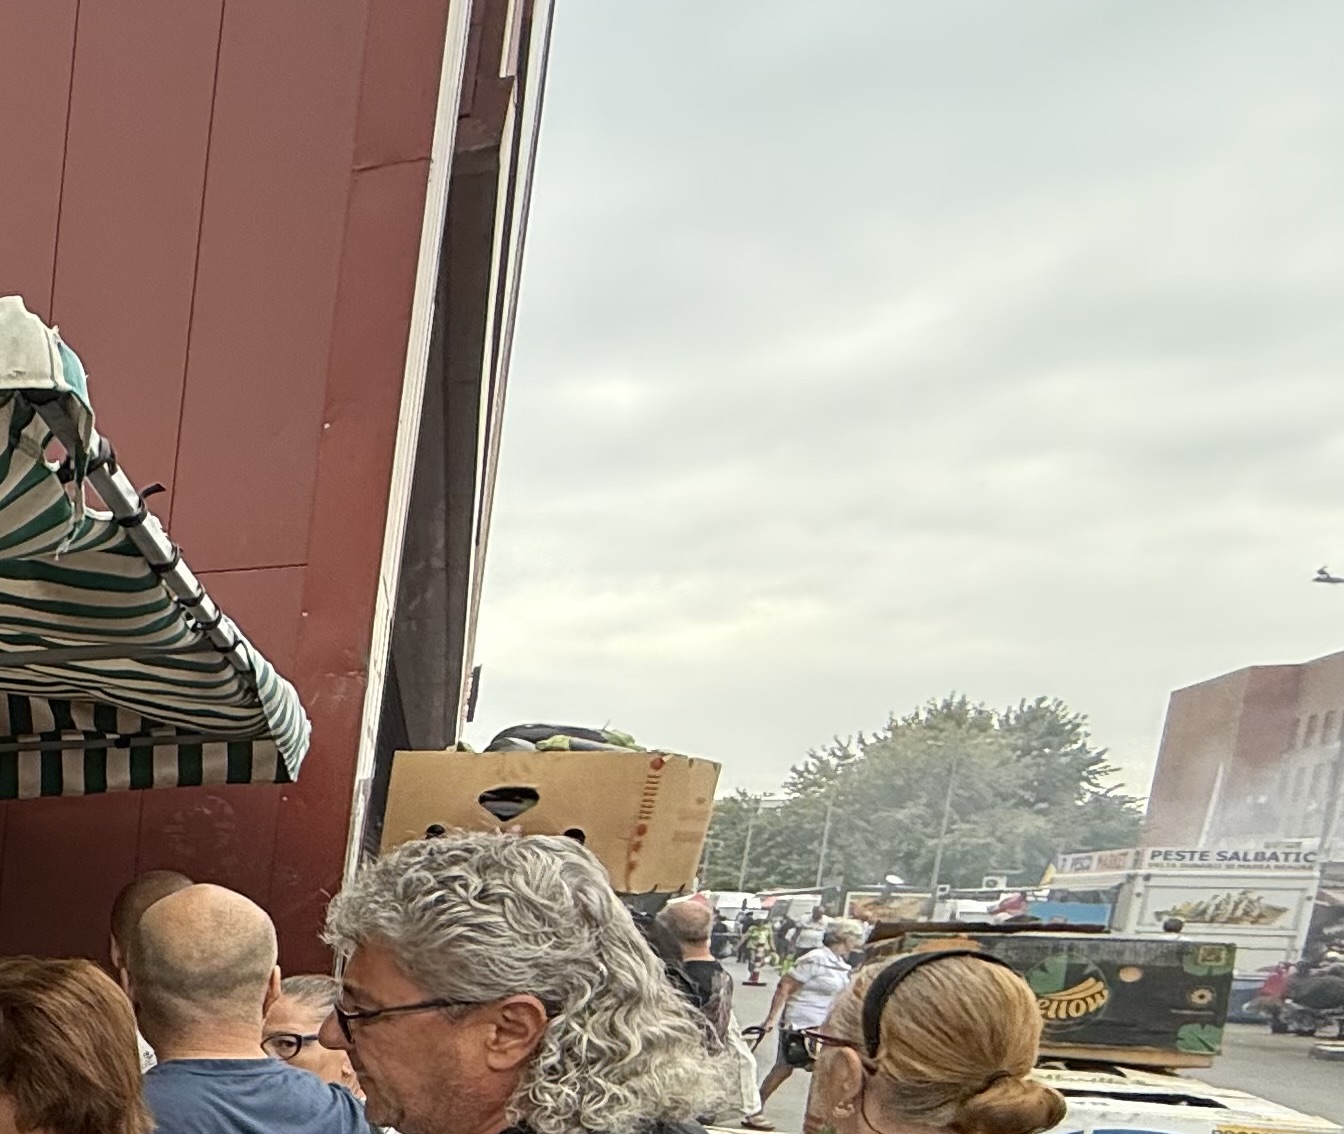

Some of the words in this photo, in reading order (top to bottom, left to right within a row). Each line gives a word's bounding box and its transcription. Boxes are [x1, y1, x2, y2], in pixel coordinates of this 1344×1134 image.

[1150, 850, 1210, 861] PESTE
[1216, 851, 1318, 863] SALBATIC
[1038, 988, 1110, 1019] ellow
